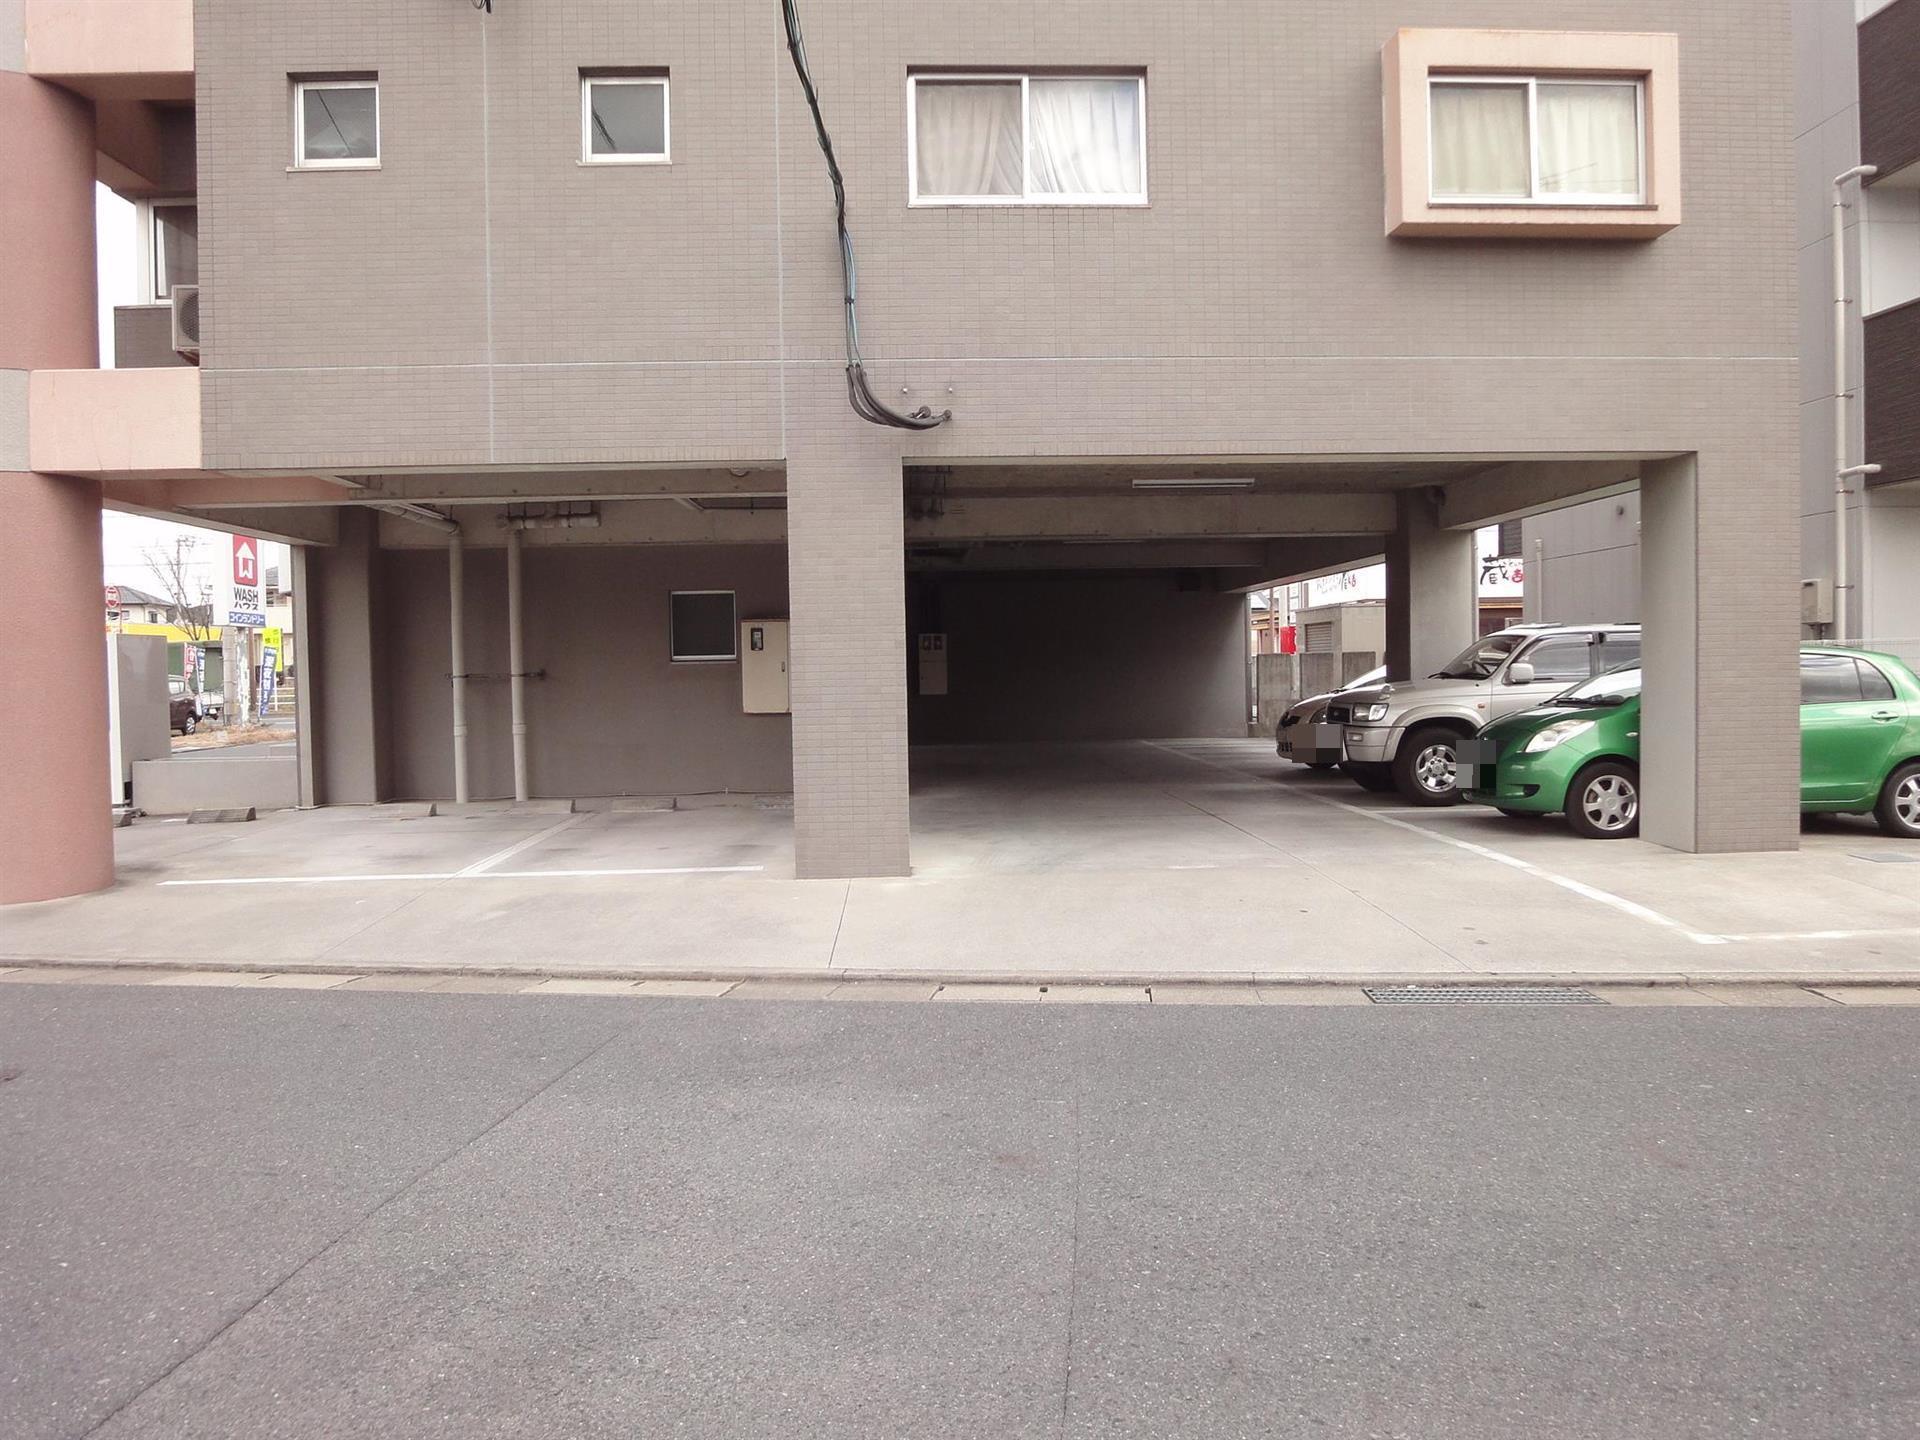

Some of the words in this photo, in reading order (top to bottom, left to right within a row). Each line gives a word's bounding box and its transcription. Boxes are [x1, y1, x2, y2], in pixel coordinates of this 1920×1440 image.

[234, 587, 259, 603] WASH
[234, 602, 259, 611] ハウス
[230, 613, 264, 624] コインランドリー
